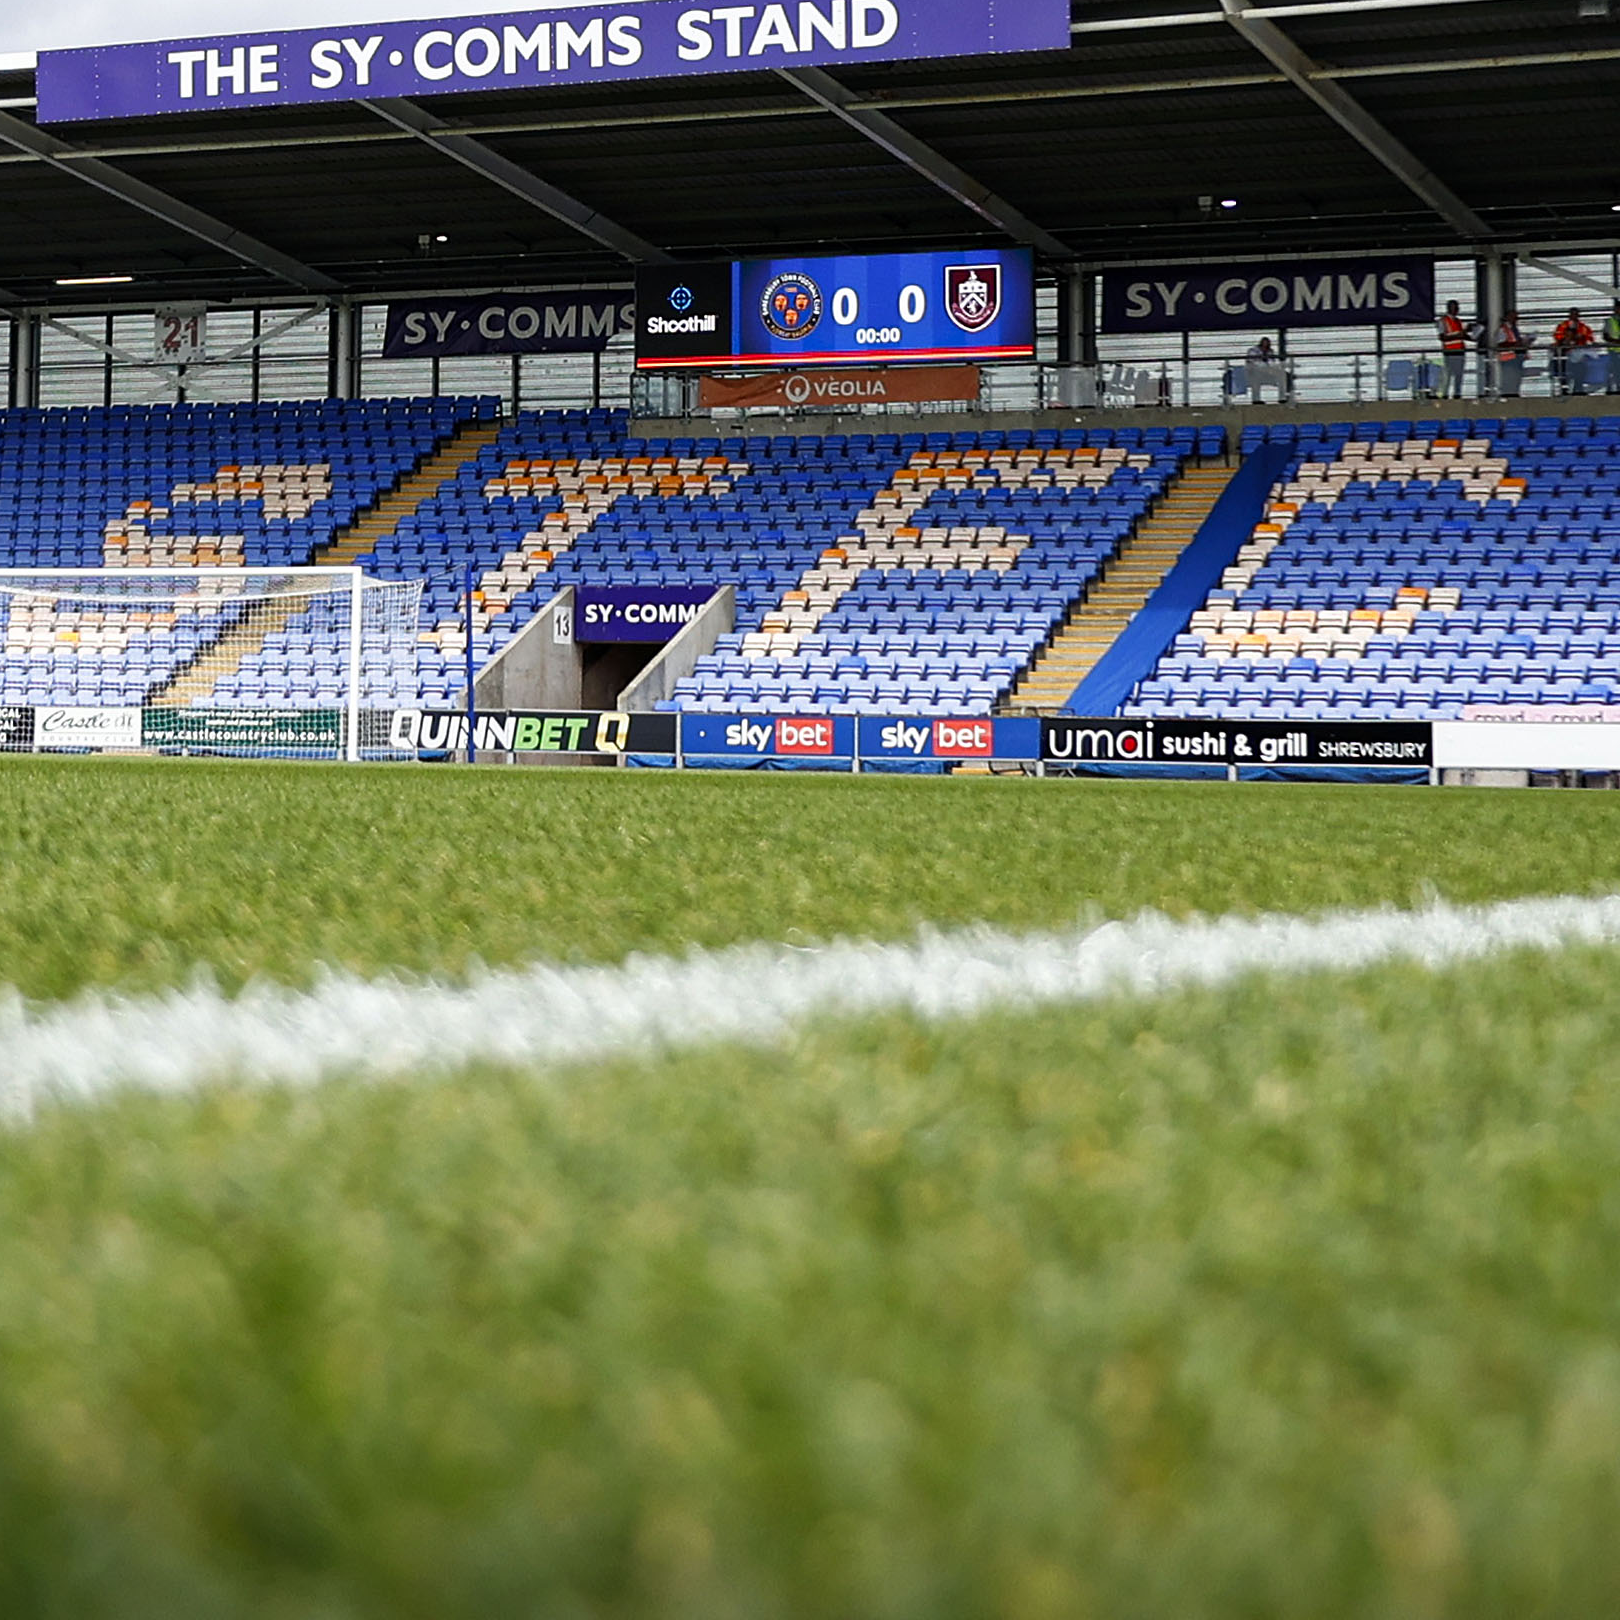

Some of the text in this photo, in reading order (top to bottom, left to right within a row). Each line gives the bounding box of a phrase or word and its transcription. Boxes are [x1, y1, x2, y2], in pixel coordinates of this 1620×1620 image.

[168, 43, 279, 99] THE
[831, 287, 859, 326] 0
[898, 284, 926, 324] 0
[161, 315, 200, 349] 21
[647, 314, 716, 335] Shoothill
[855, 326, 901, 344] 00:00
[813, 379, 887, 398] VEOLIA
[554, 613, 571, 637] 13
[41, 709, 111, 732] Castle
[143, 727, 336, 746] www.castlecountryclub.co.uk
[389, 709, 589, 750] QUINNBET
[725, 718, 828, 752] sky bet
[880, 719, 987, 754] sky bet
[1048, 721, 1428, 763] umai sushi & grill SHREWSBURY
